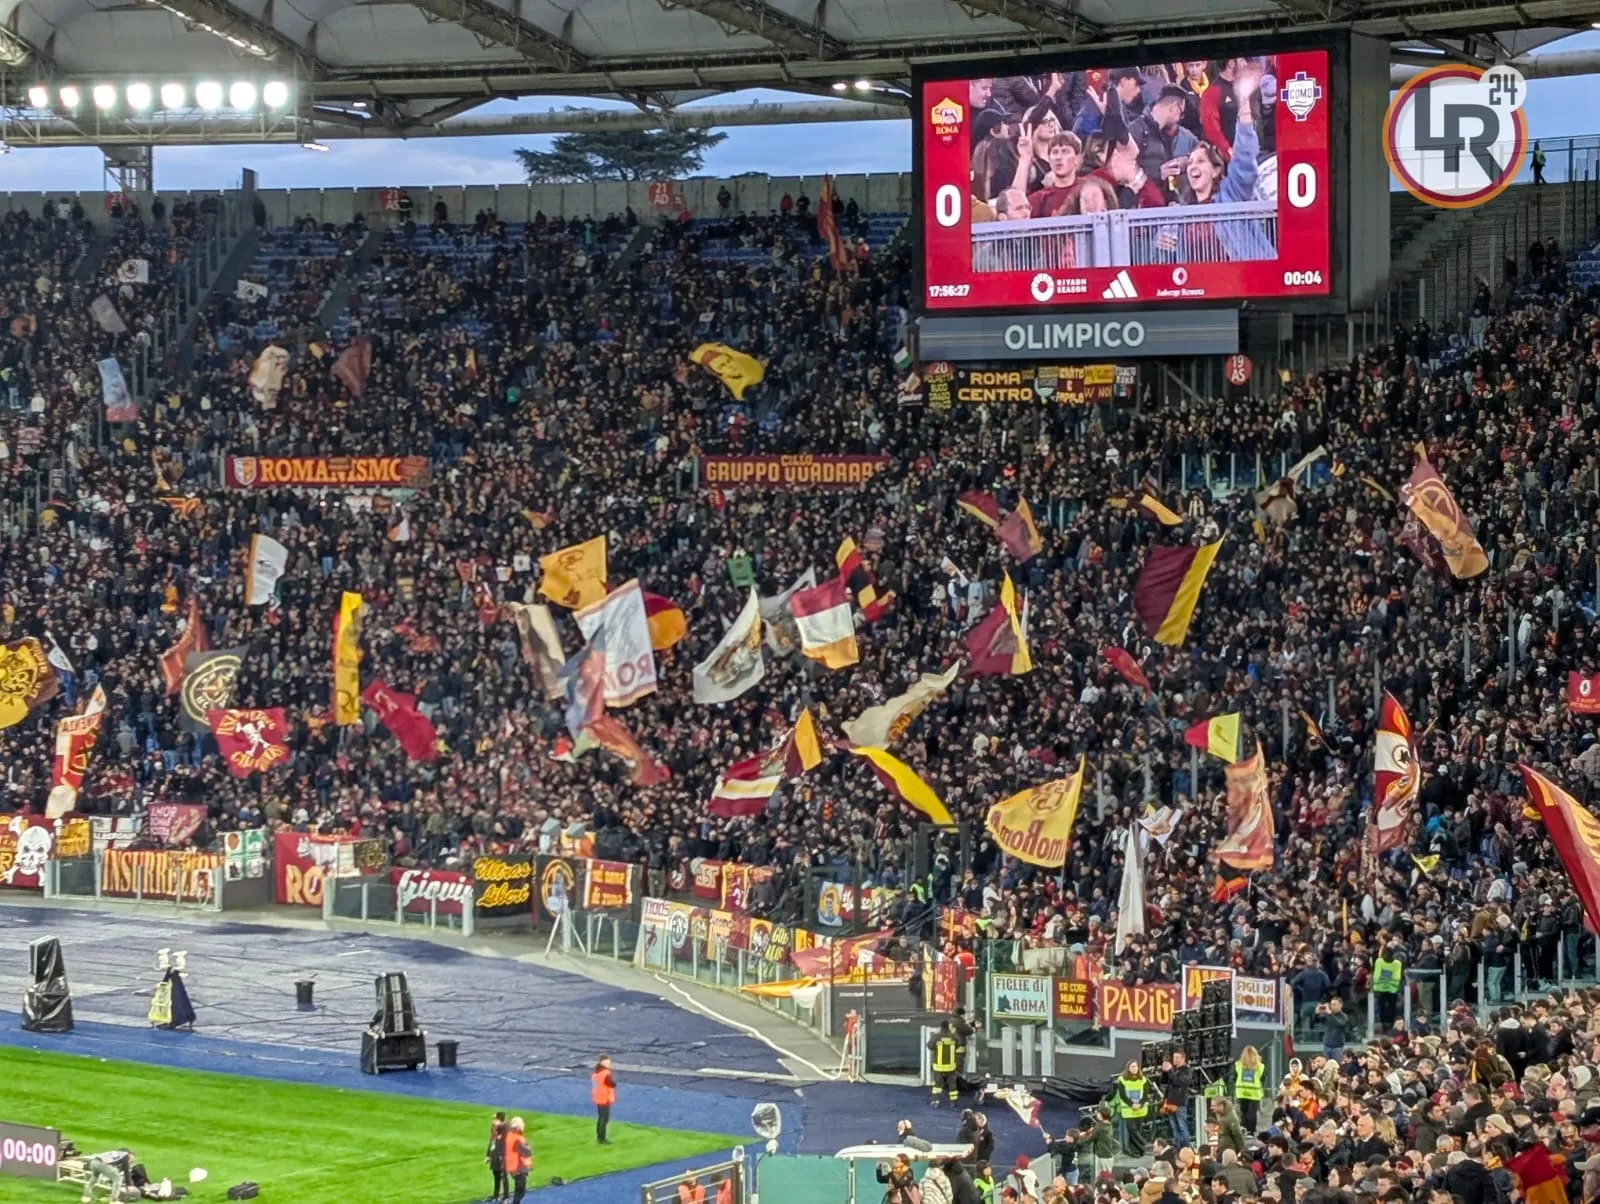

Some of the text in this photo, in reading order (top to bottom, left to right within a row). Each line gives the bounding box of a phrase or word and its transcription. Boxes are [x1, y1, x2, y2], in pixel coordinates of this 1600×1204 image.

[1287, 163, 1316, 208] 0
[935, 185, 962, 227] 0
[1283, 271, 1322, 286] 00:04
[929, 283, 969, 298] 17:56:27
[1057, 286, 1087, 294] SEASON
[1004, 321, 1145, 352] OLIMPICO
[934, 362, 948, 374] 20
[1231, 355, 1245, 368] 19
[970, 372, 1021, 385] ROMA
[1231, 369, 1246, 382] AS
[958, 388, 1033, 401] CENTRO
[706, 462, 780, 481] GRUPPO
[996, 978, 1044, 992] FIGLIE di
[1237, 982, 1273, 994] FIGLI DI
[1013, 998, 1046, 1013] ROMA
[1060, 994, 1086, 1003] NUN SE
[3, 1137, 56, 1167] 00:00
